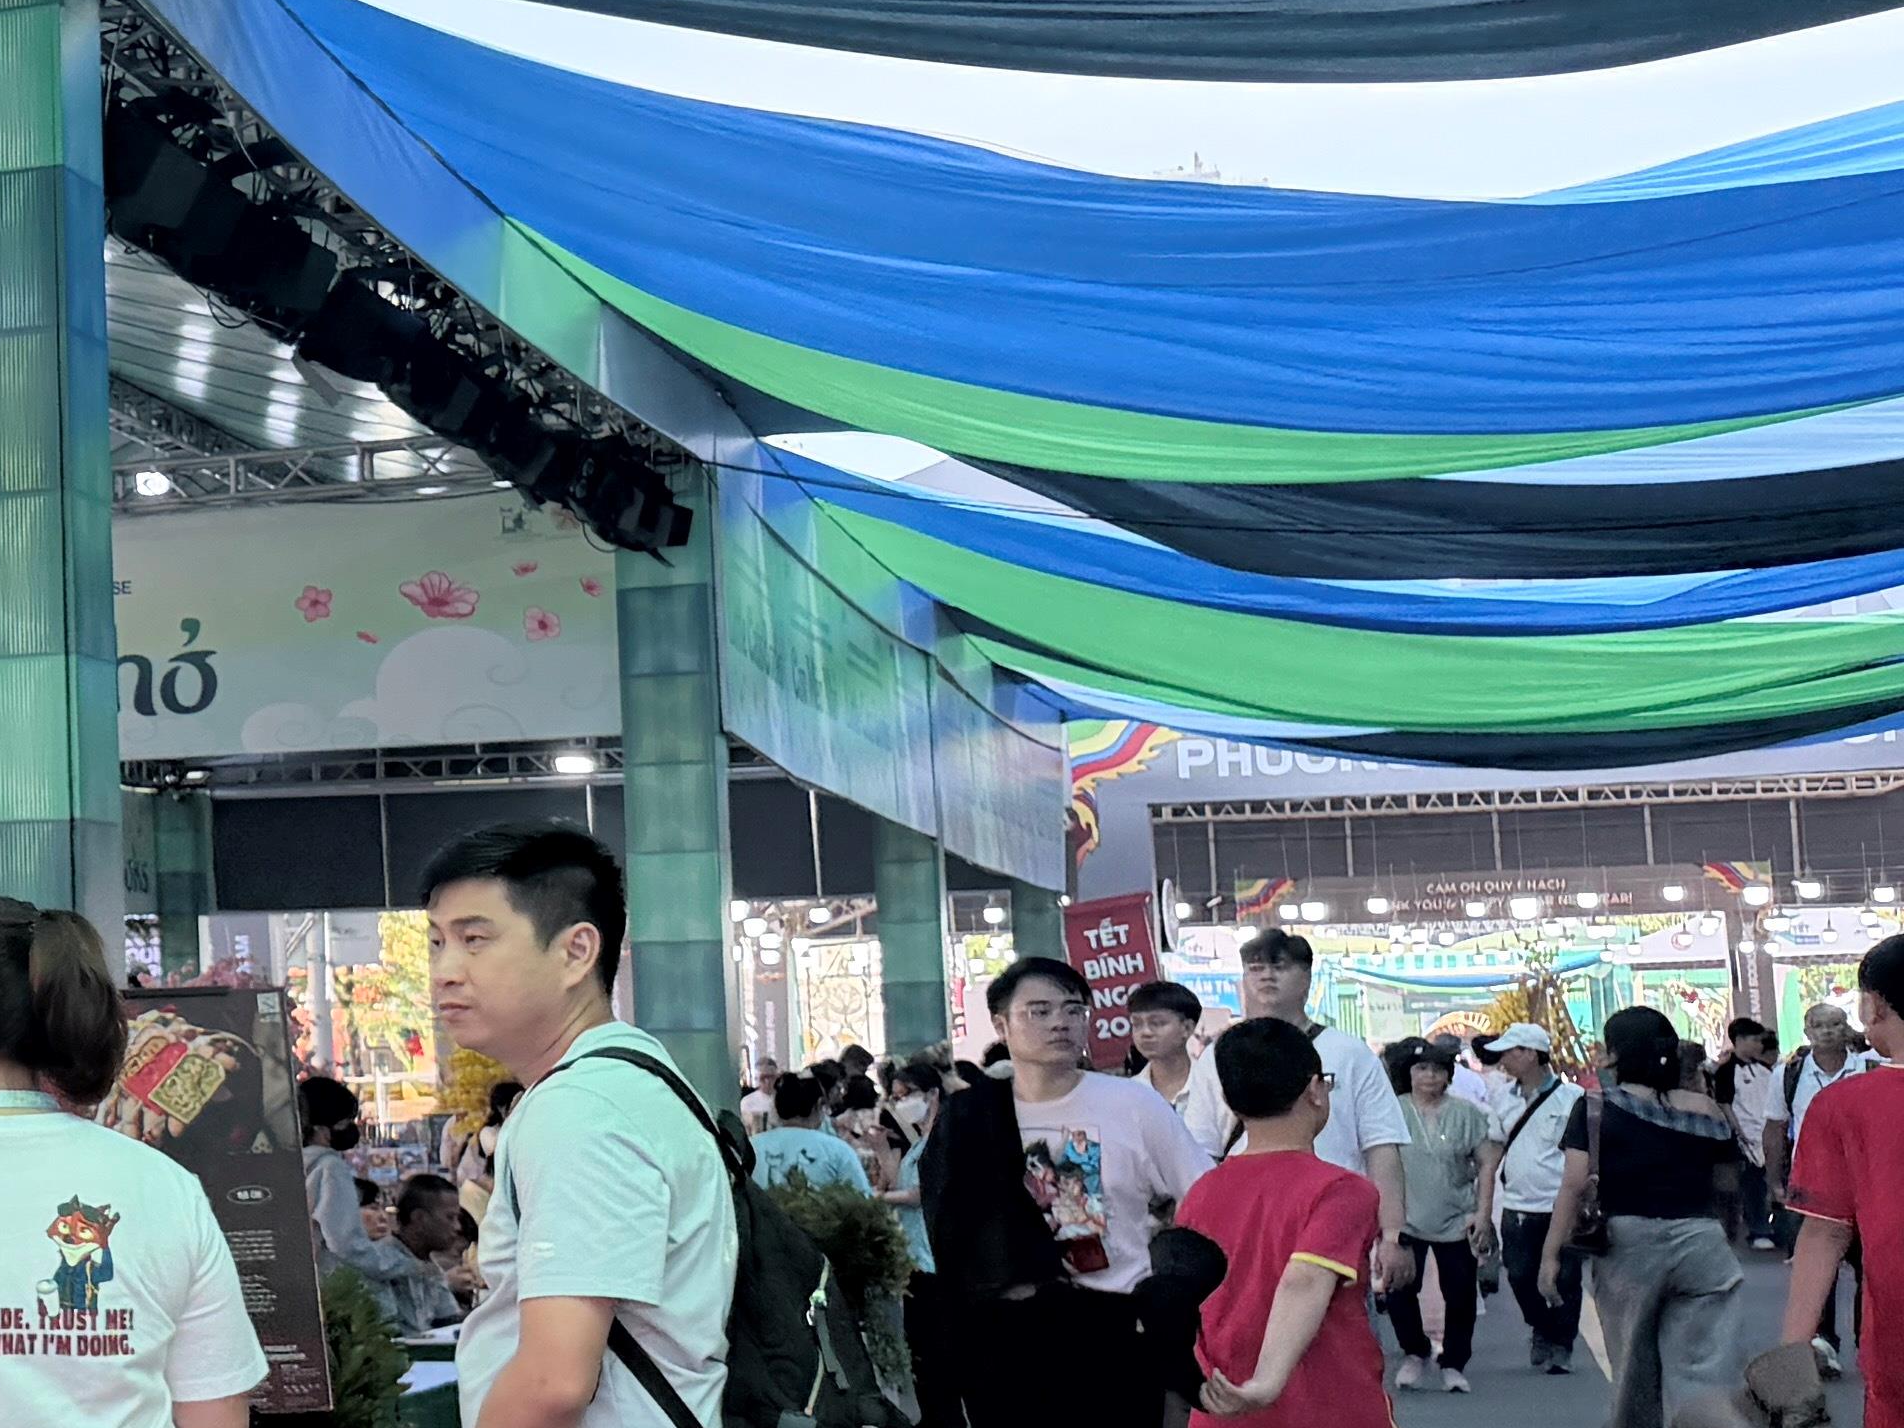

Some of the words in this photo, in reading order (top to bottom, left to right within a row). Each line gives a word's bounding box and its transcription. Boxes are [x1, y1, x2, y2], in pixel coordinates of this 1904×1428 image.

[1083, 917, 1130, 949] TẾT
[1095, 1017, 1131, 1040] 20
[38, 1308, 99, 1331] TRUST
[104, 1308, 135, 1331] ME!
[41, 1334, 72, 1356] I'M
[76, 1334, 136, 1357] DOING.
